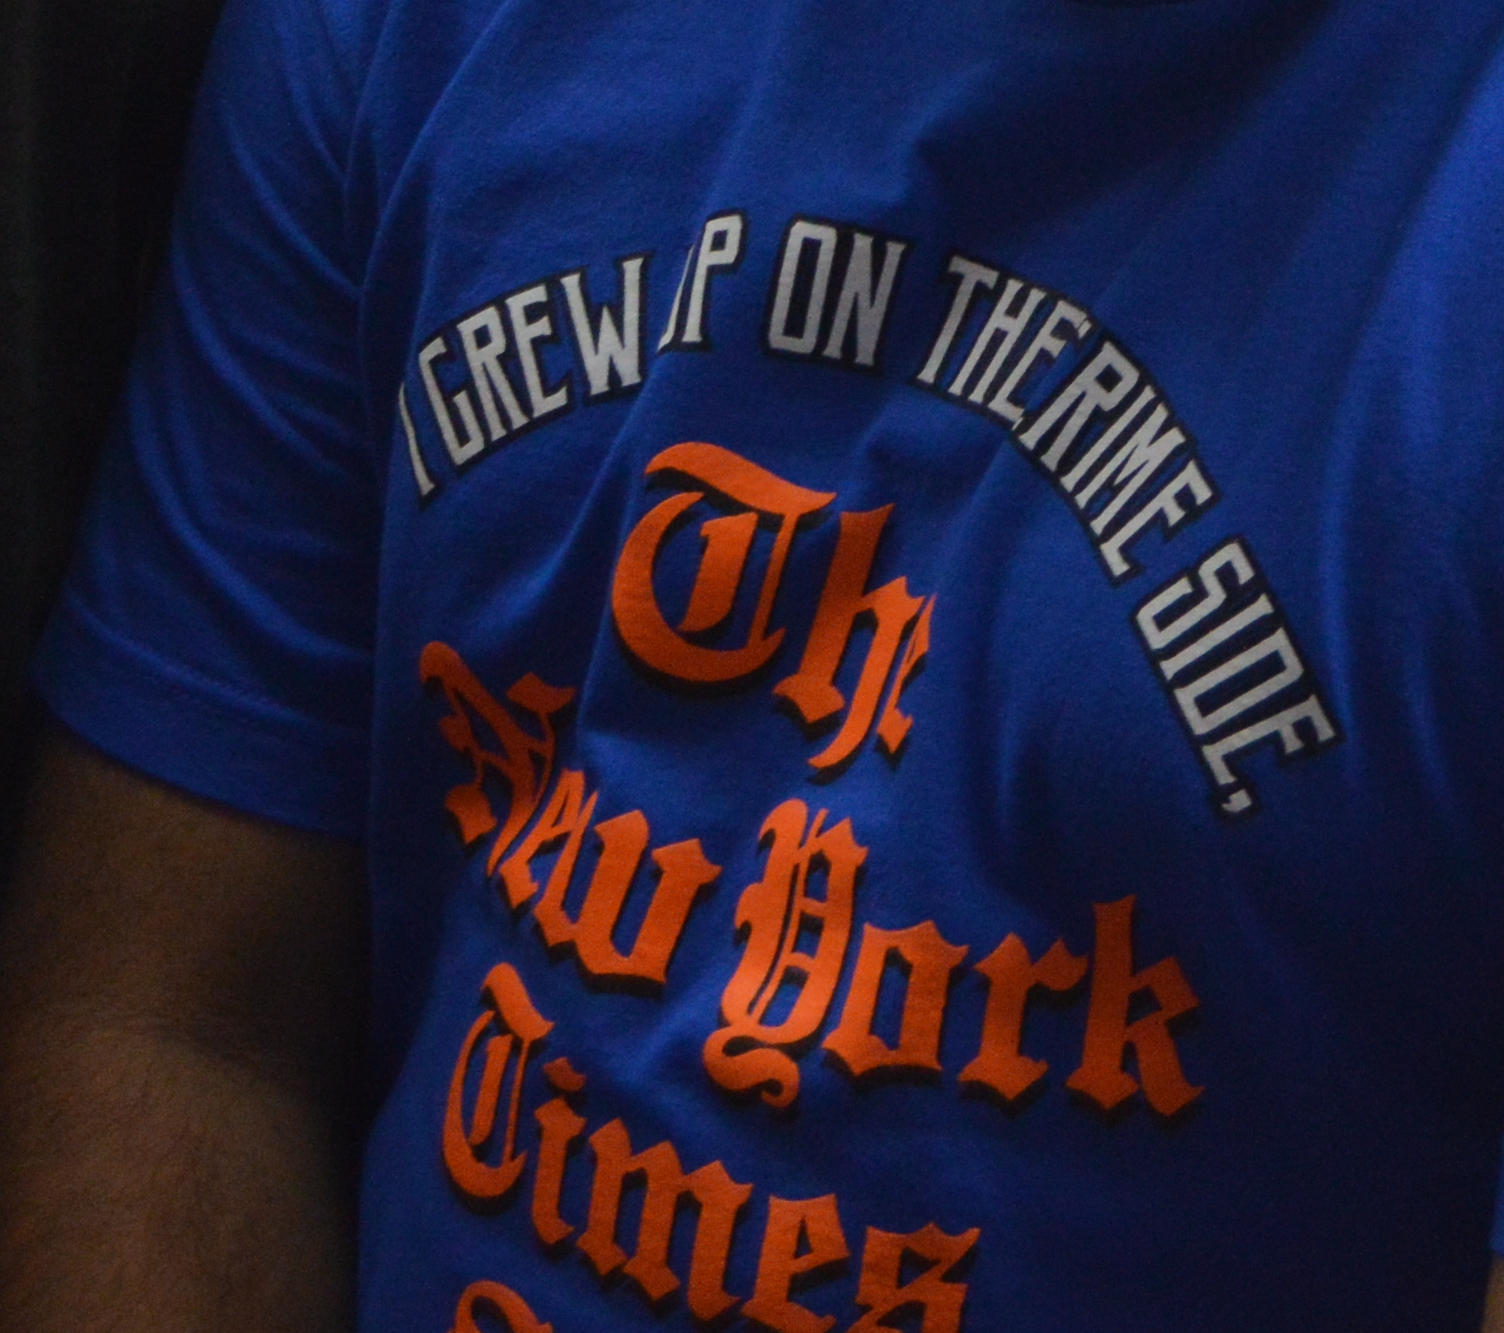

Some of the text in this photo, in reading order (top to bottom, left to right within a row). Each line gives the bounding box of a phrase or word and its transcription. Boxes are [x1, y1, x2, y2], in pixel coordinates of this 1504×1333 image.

[418, 256, 644, 467] GREW
[767, 220, 907, 365] ON
[916, 255, 1081, 425] THE
[1011, 319, 1214, 579] RIME
[1136, 542, 1336, 813] SIDE,
[419, 640, 1206, 1117] New York
[443, 962, 981, 1333] Times
